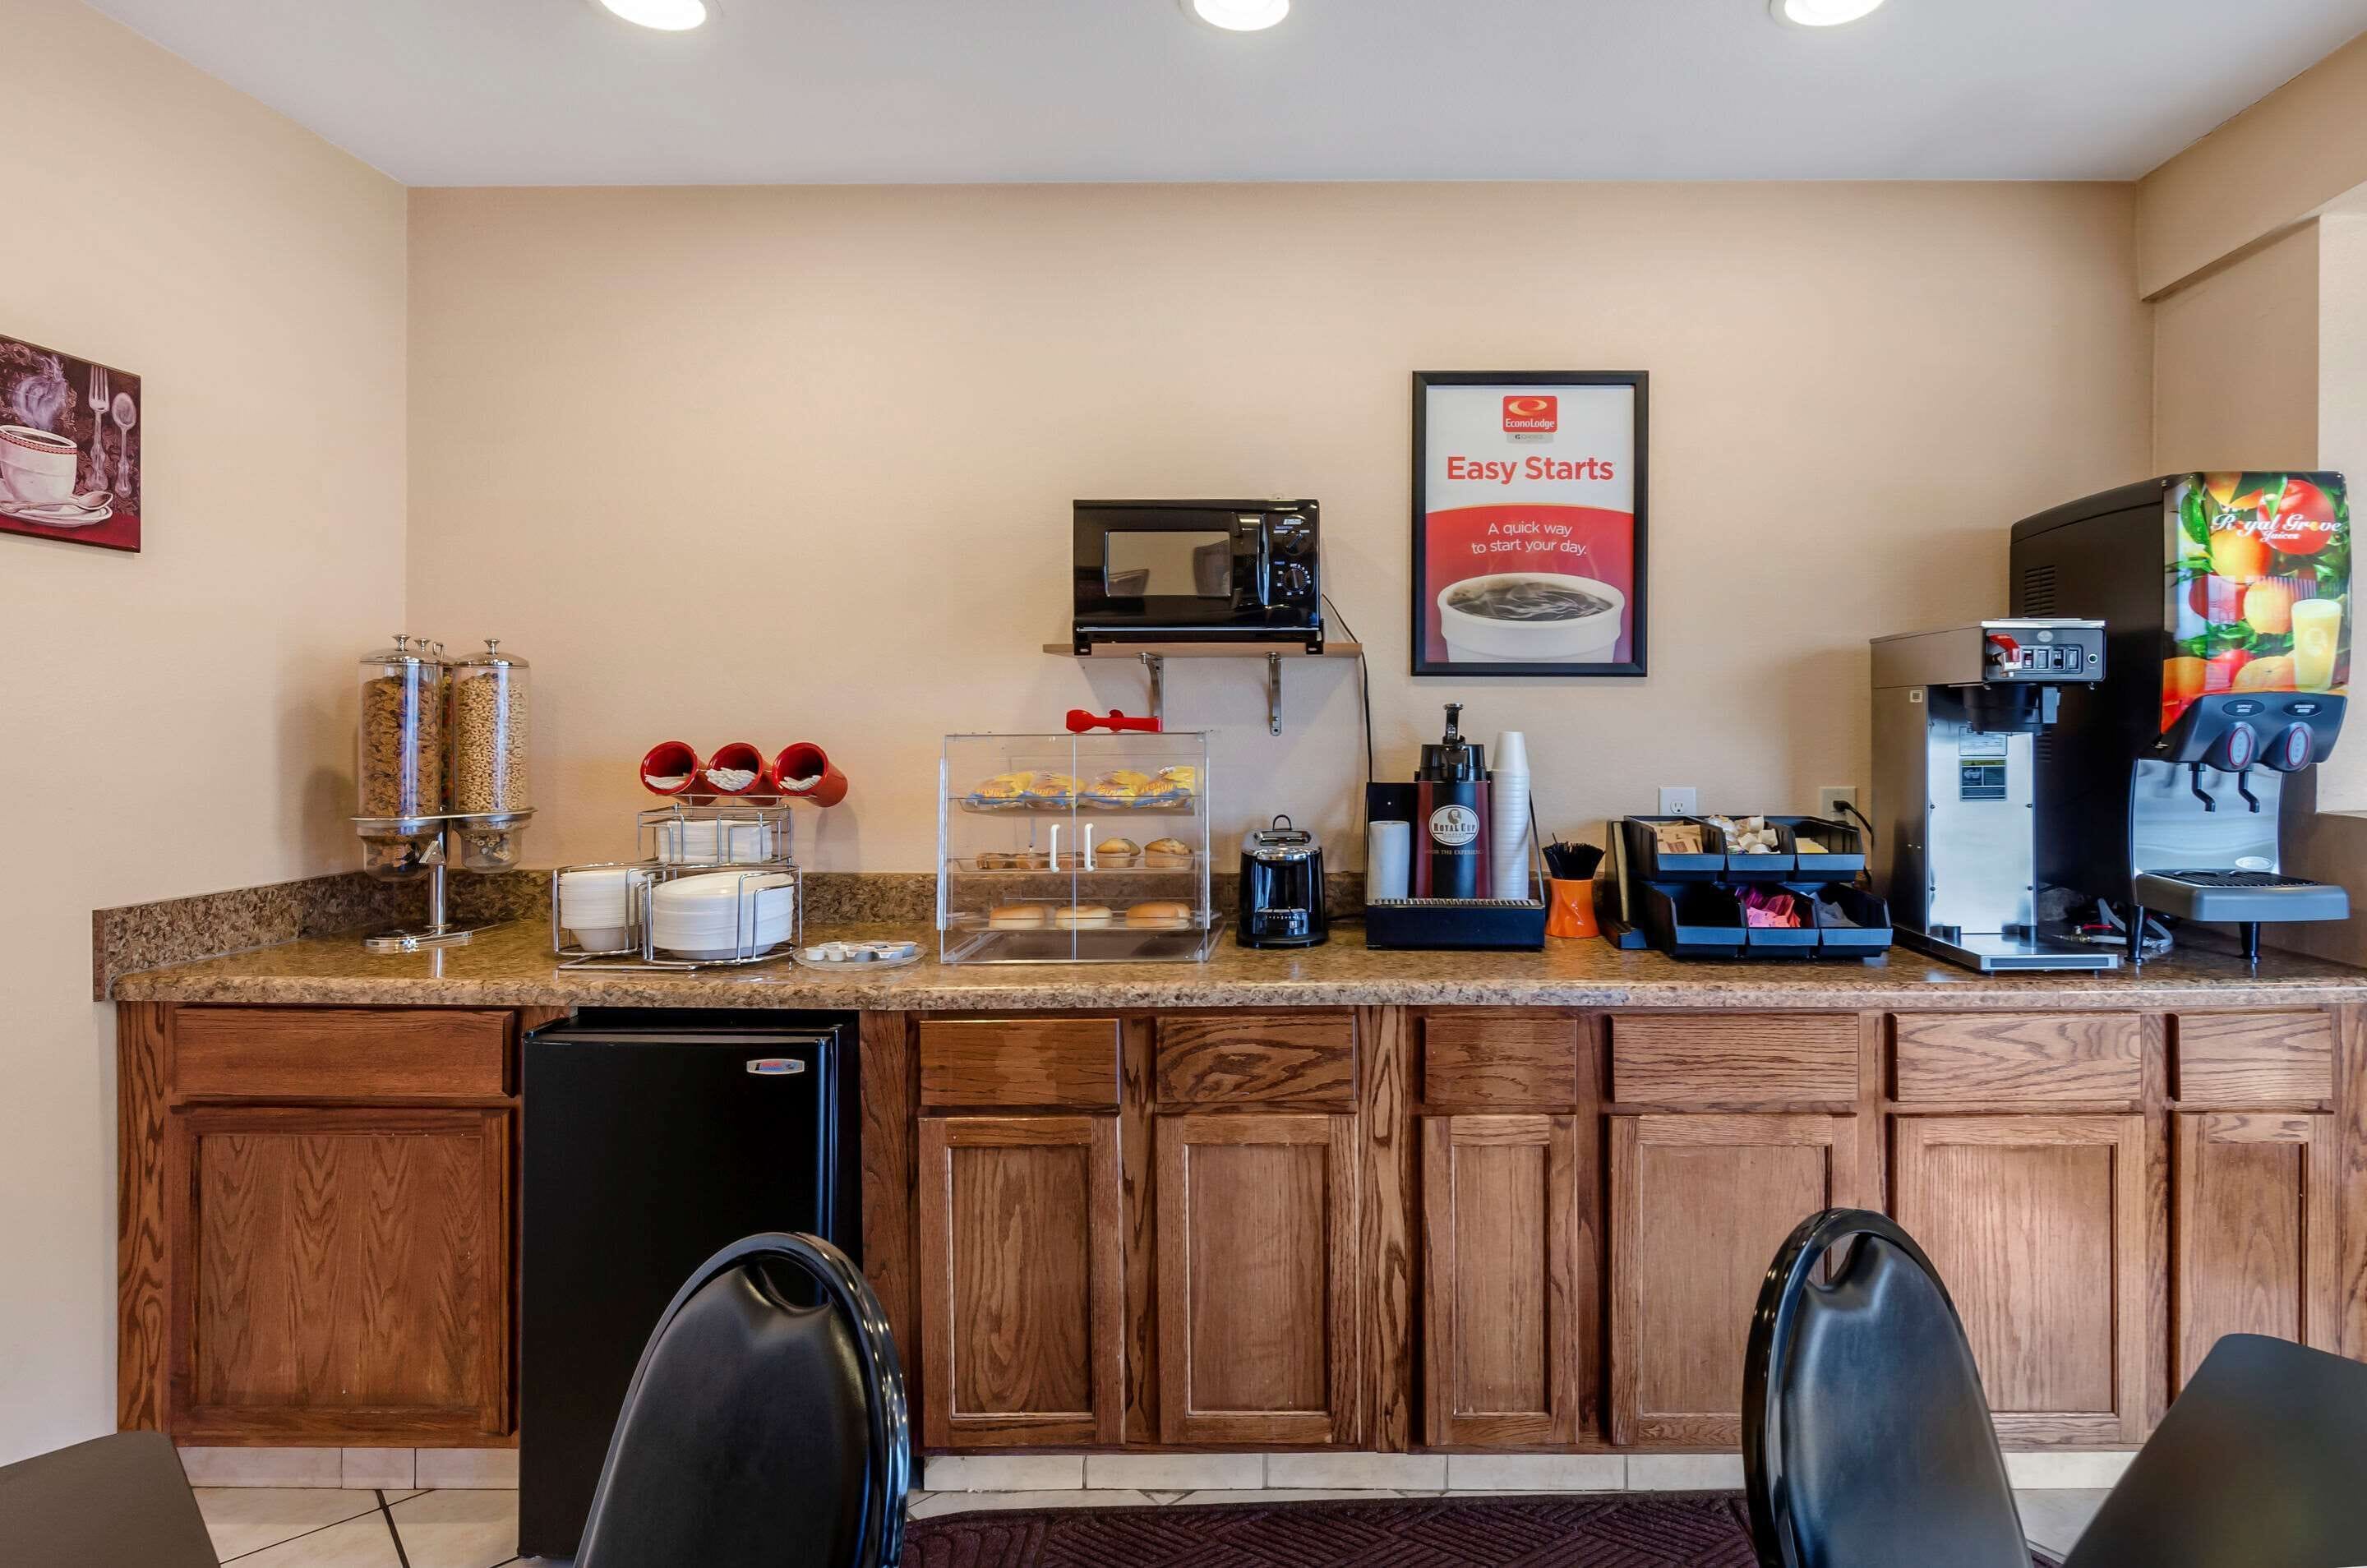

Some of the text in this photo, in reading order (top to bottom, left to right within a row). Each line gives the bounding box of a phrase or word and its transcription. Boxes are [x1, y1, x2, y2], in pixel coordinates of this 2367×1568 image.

[1505, 417, 1555, 430] EconoLodge
[1446, 455, 1615, 485] Easy Starts
[1488, 520, 1573, 538] A quick way
[1471, 539, 1587, 556] to start your day.
[1433, 823, 1459, 832] ROYAL
